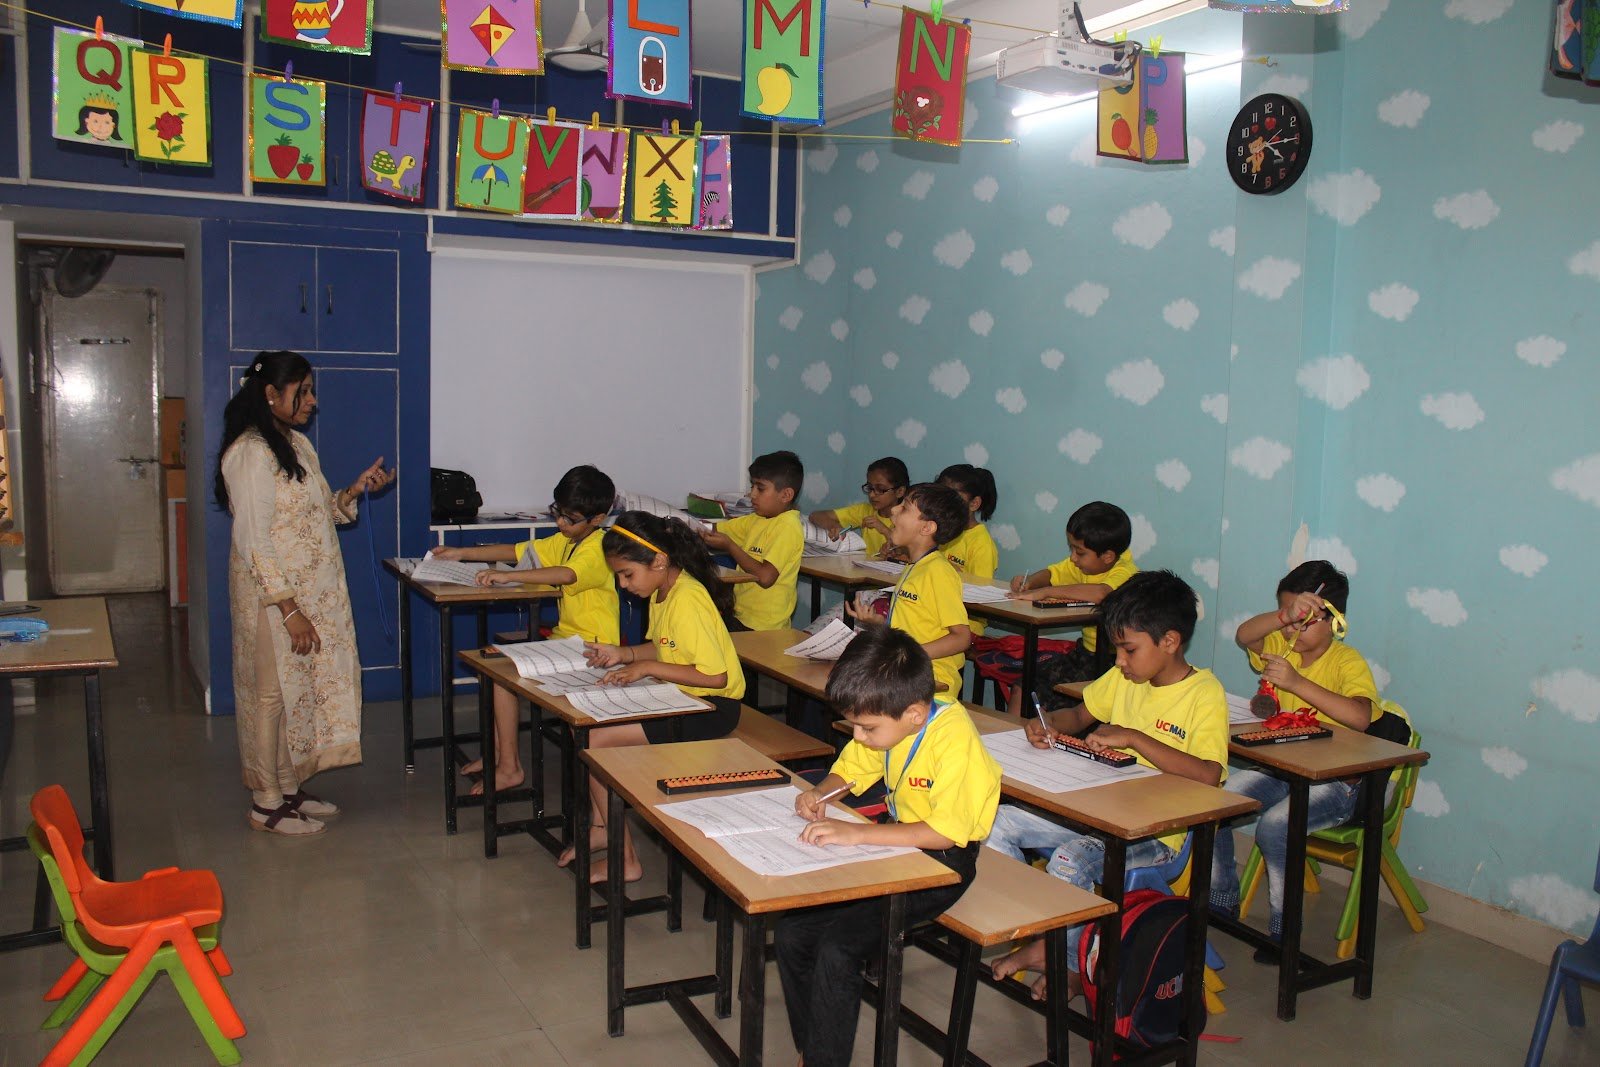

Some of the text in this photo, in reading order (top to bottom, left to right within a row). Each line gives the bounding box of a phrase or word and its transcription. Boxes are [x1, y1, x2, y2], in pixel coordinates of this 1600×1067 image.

[628, 0, 680, 37] L
[753, 0, 812, 57] M
[76, 39, 123, 92] Q
[909, 16, 956, 81] N
[149, 55, 186, 108] R
[1143, 57, 1168, 109] P
[264, 82, 311, 131] S
[374, 95, 421, 147] T
[1252, 112, 1258, 123] 11
[1264, 102, 1273, 114] 12
[1290, 116, 1297, 127] 2
[473, 116, 517, 160] U
[534, 125, 570, 170] V
[1237, 146, 1244, 156] 9
[1241, 127, 1249, 138] 10
[643, 135, 688, 181] X
[1241, 162, 1248, 174] 8
[1251, 173, 1258, 184] 7
[1156, 718, 1186, 740] UCMAS
